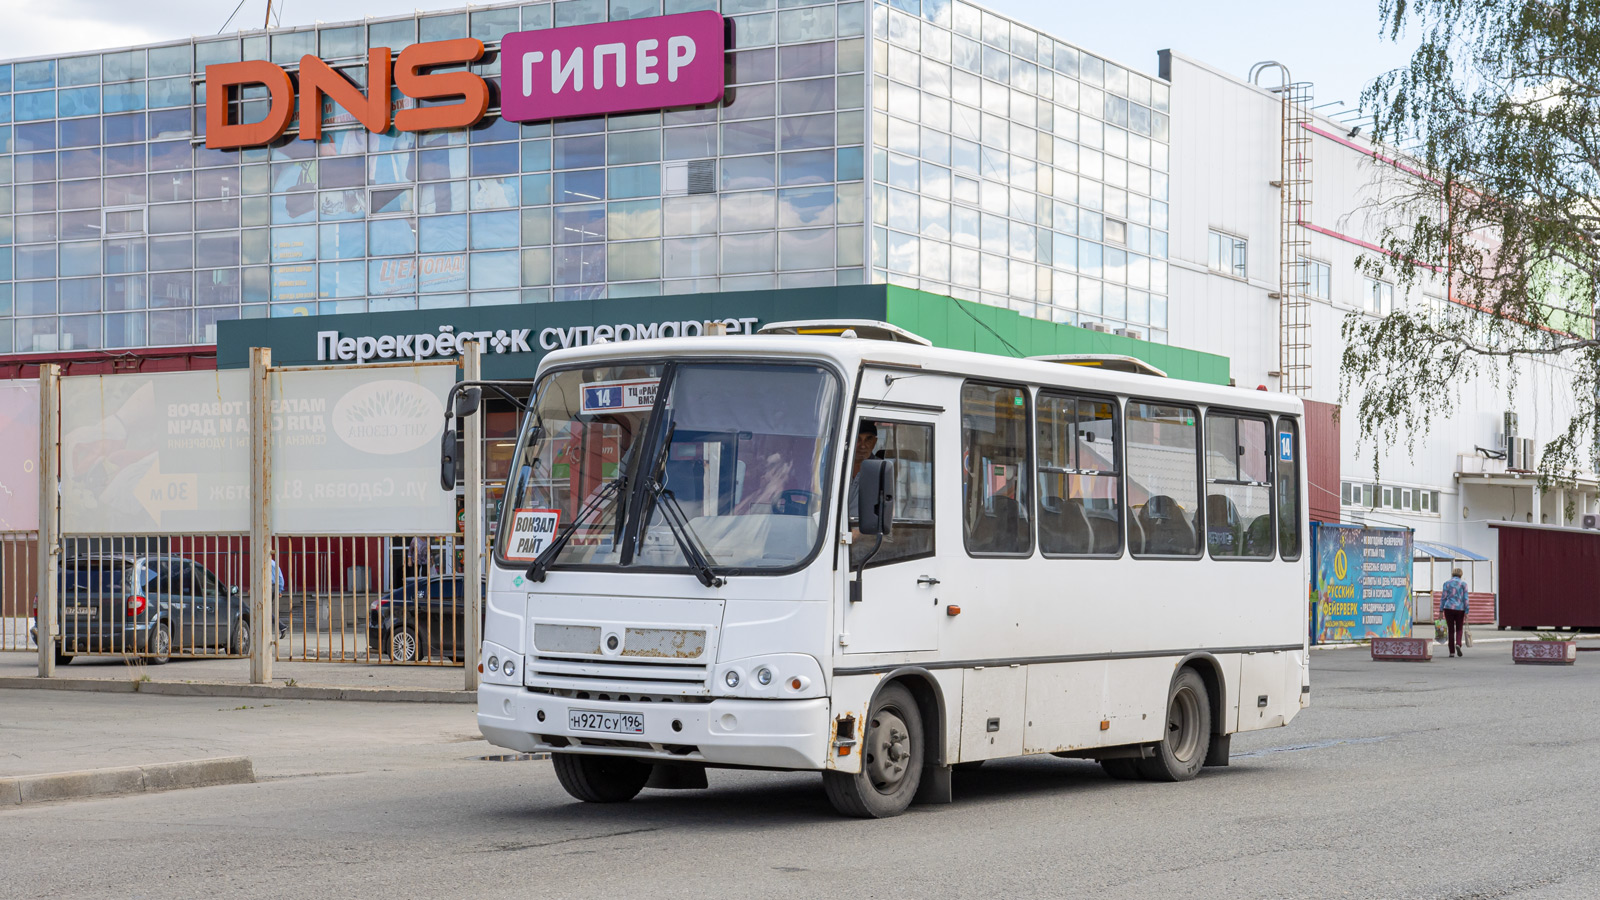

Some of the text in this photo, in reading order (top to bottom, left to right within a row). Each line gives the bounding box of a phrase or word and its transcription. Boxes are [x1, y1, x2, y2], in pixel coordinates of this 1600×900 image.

[522, 34, 698, 97] ГИПЕР
[205, 37, 490, 150] DNS
[596, 388, 611, 407] 14
[628, 387, 638, 397] ТЦ
[1281, 437, 1290, 457] 14
[515, 517, 556, 533] ВОКЗАЛ
[517, 535, 543, 553] РАЙТ
[1327, 584, 1354, 598] РУССКИЙ
[1323, 601, 1358, 616] ФЕЙЕРВЕРК
[622, 715, 640, 728] 196
